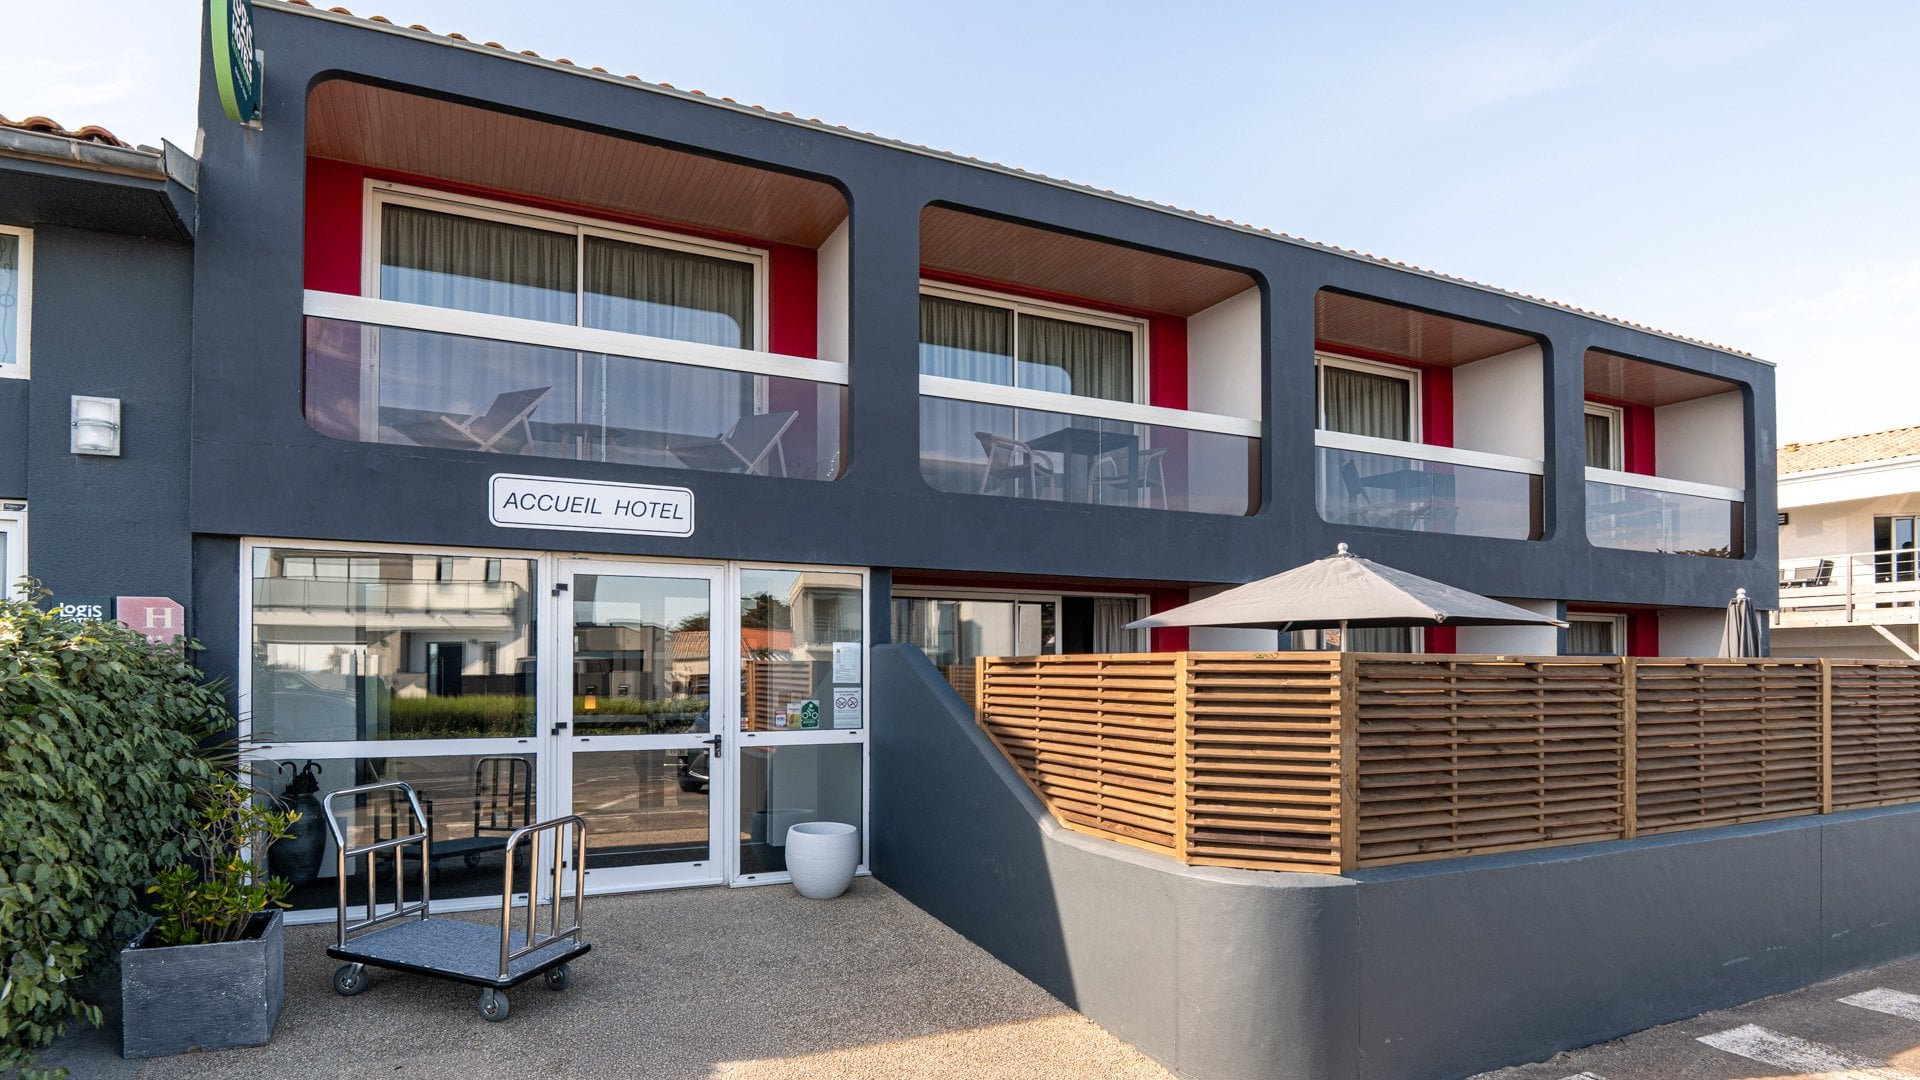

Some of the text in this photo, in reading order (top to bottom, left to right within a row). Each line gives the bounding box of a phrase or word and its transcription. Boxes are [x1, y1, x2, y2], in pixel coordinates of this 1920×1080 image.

[502, 492, 684, 520] ACCUEIL HOTEL
[144, 606, 177, 629] H
